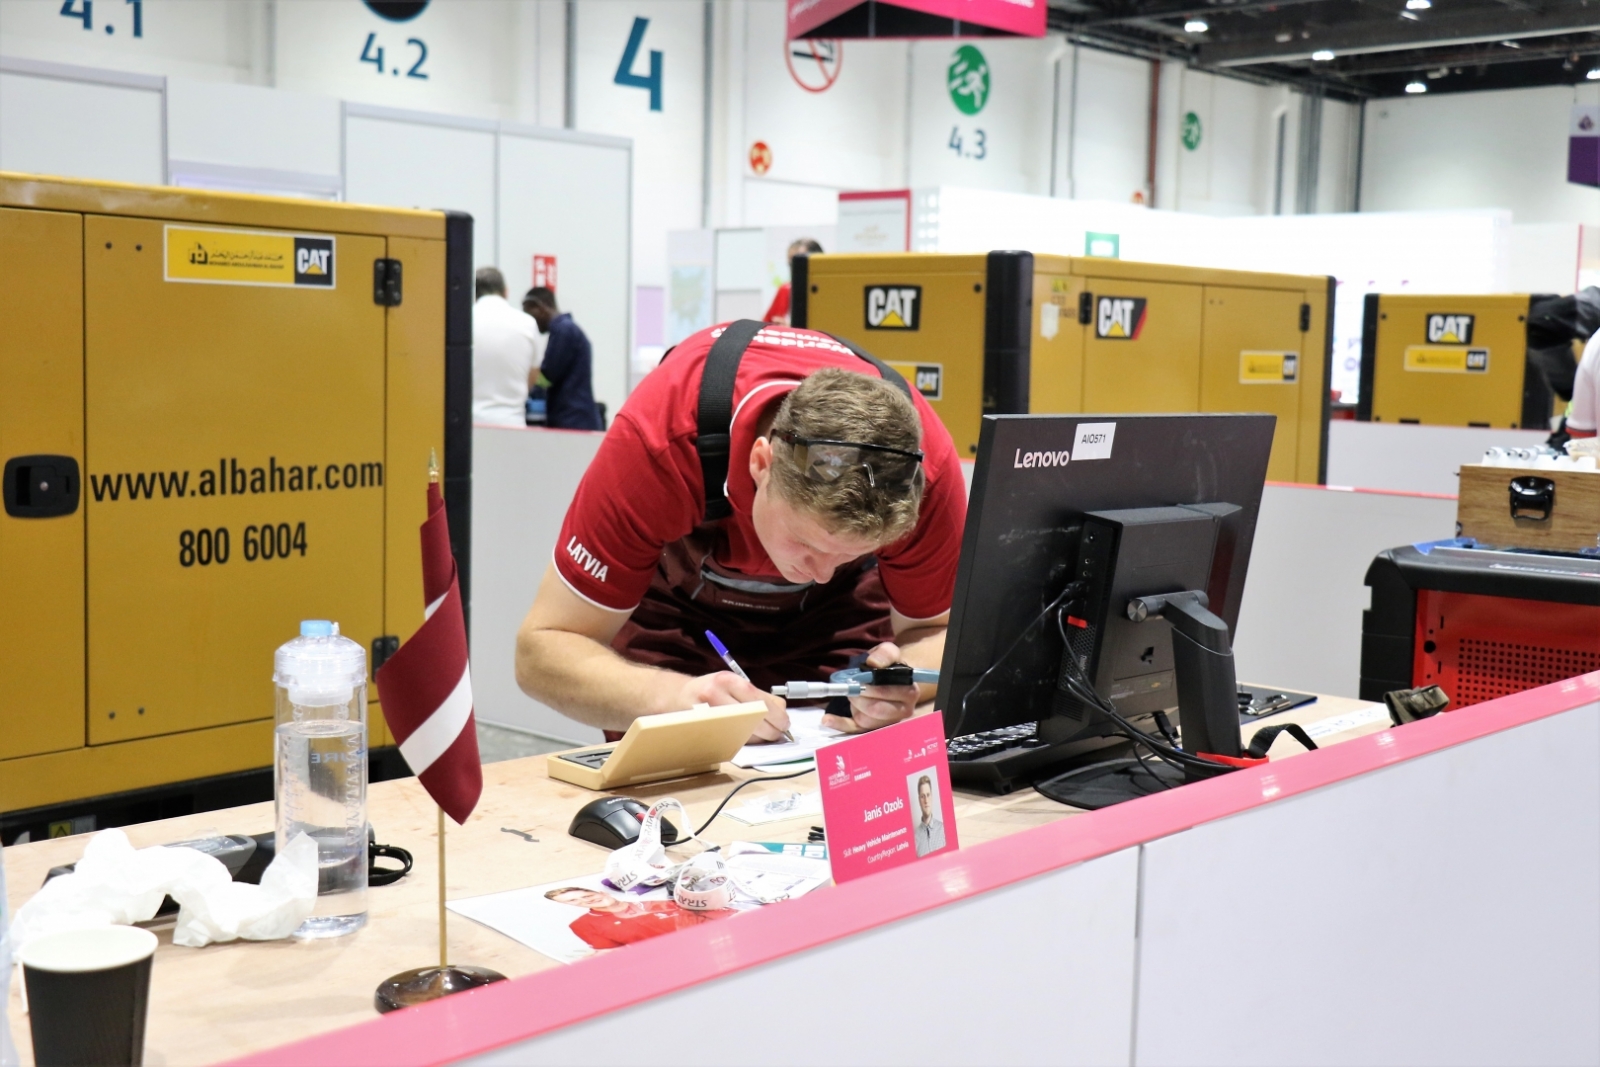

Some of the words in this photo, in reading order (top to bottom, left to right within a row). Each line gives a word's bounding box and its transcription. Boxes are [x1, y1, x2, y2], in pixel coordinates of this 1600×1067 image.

[59, 0, 143, 38] 4.1
[359, 32, 429, 80] 4.2
[614, 17, 664, 112] 4
[948, 125, 988, 160] 4.3
[296, 248, 330, 275] CAT
[867, 288, 917, 328] CAT
[1098, 298, 1135, 338] CAT
[1428, 314, 1471, 343] CAT
[917, 370, 938, 391] CAT
[1081, 433, 1107, 444] AIO571
[1013, 447, 1070, 469] Lenovo
[90, 456, 384, 502] www.albahar.com
[179, 526, 230, 568] 800
[243, 521, 308, 562] 6004
[566, 535, 609, 583] LATVIA
[863, 804, 883, 823] Janis
[883, 796, 904, 815] Ozols
[866, 836, 882, 849] Vehicle
